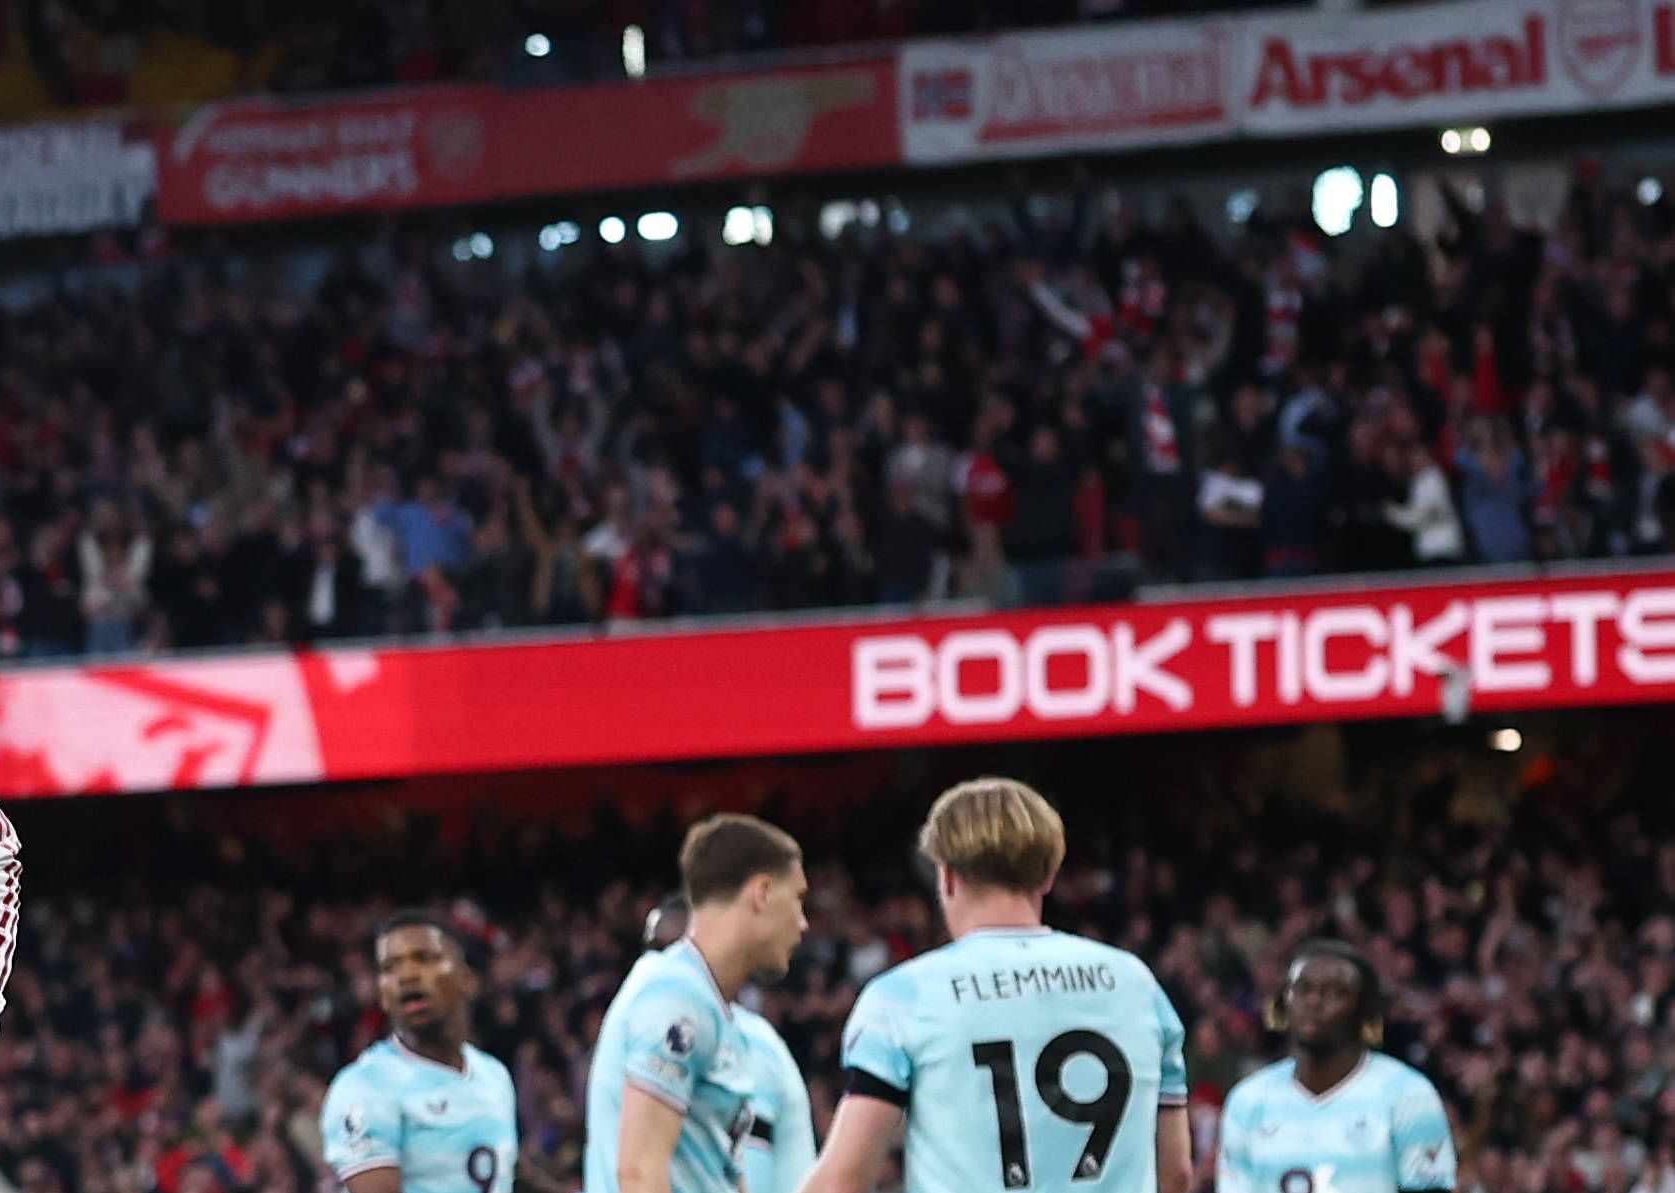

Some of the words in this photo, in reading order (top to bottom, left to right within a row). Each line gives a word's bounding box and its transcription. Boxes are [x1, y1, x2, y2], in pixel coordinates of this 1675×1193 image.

[1249, 12, 1547, 110] Arsenal
[851, 616, 1194, 730] BOOK
[1206, 588, 1675, 706] TICKETS
[950, 962, 1117, 1004] FLEMMING
[971, 1027, 1133, 1192] 19
